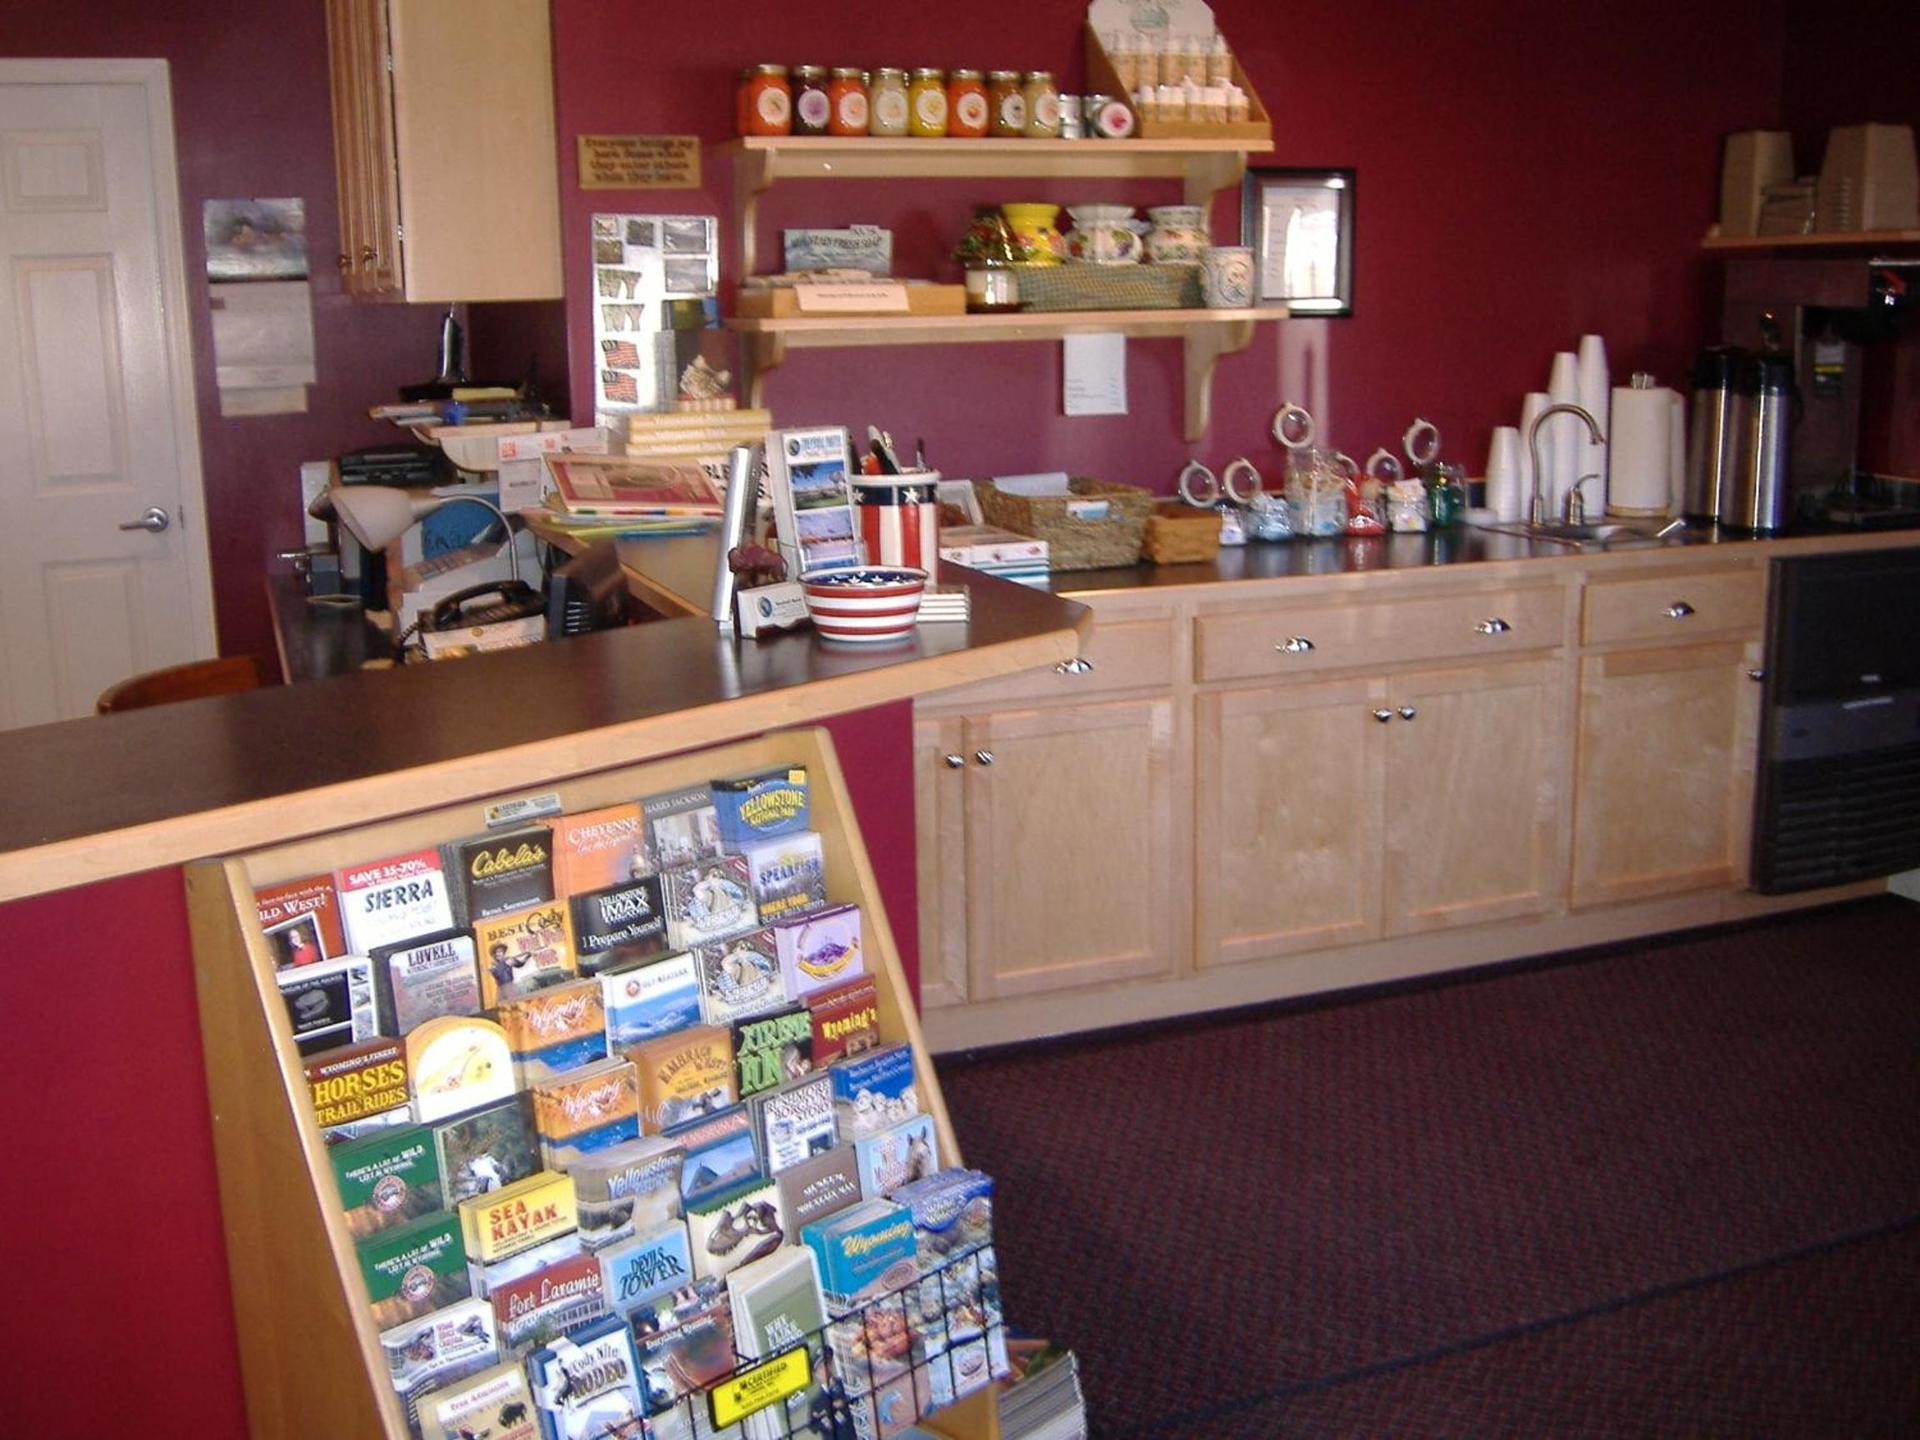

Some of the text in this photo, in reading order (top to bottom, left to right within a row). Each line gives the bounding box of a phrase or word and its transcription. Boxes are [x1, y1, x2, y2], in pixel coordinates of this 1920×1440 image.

[740, 789, 805, 821] YELLOWSTONE
[568, 817, 639, 845] CHEYENNE
[349, 869, 381, 885] SAVE
[472, 843, 547, 880] Cabela's
[258, 894, 327, 921] ILD WEST!
[365, 879, 433, 913] SIERRA
[599, 886, 649, 904] YELLOWSTONE
[601, 896, 650, 917] IMAX
[488, 922, 525, 942] BEST
[589, 927, 628, 947] Prepare
[408, 943, 456, 967] LOVELL
[313, 1060, 406, 1106] HORSES
[315, 1087, 407, 1125] TRAIL RIDES
[400, 1144, 424, 1158] WILD
[608, 1155, 681, 1200] Yellowstone
[489, 1199, 528, 1225] SEA
[491, 1204, 558, 1242] KAYAK
[428, 1235, 452, 1249] WILD
[842, 1221, 913, 1256] Wyoming
[509, 1293, 535, 1318] Fort
[541, 1268, 599, 1304] Laramie
[618, 1254, 685, 1300] TOWER
[570, 1341, 618, 1373] Cody Nite
[568, 1358, 630, 1397] RODEO
